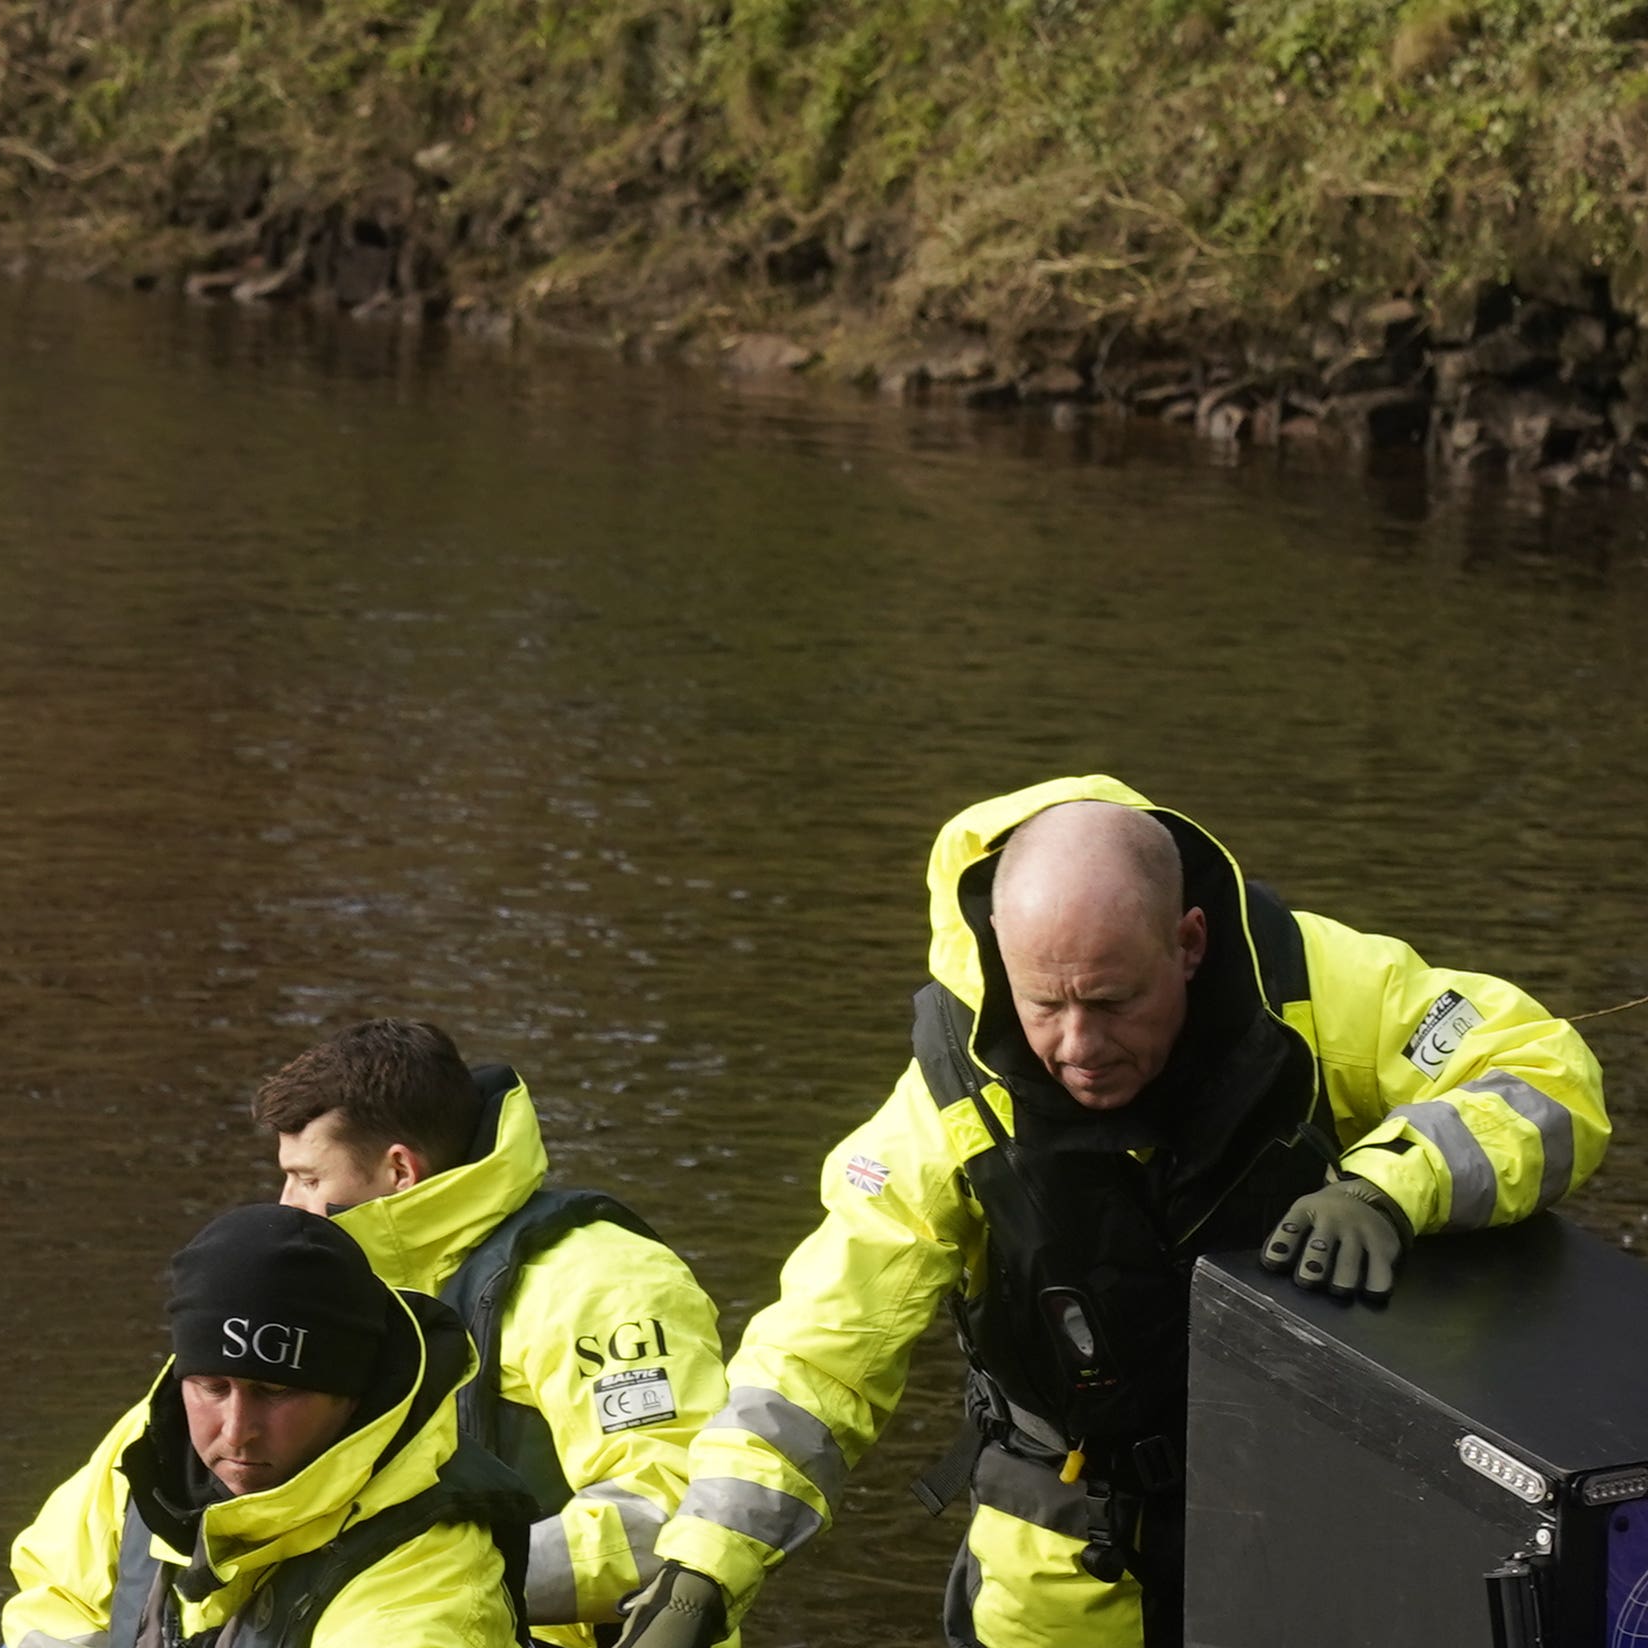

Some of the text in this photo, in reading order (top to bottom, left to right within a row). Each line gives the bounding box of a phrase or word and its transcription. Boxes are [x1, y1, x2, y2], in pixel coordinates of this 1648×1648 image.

[221, 1317, 309, 1370] SGI
[574, 1317, 674, 1380] SGI
[599, 1367, 660, 1388] BALTIC
